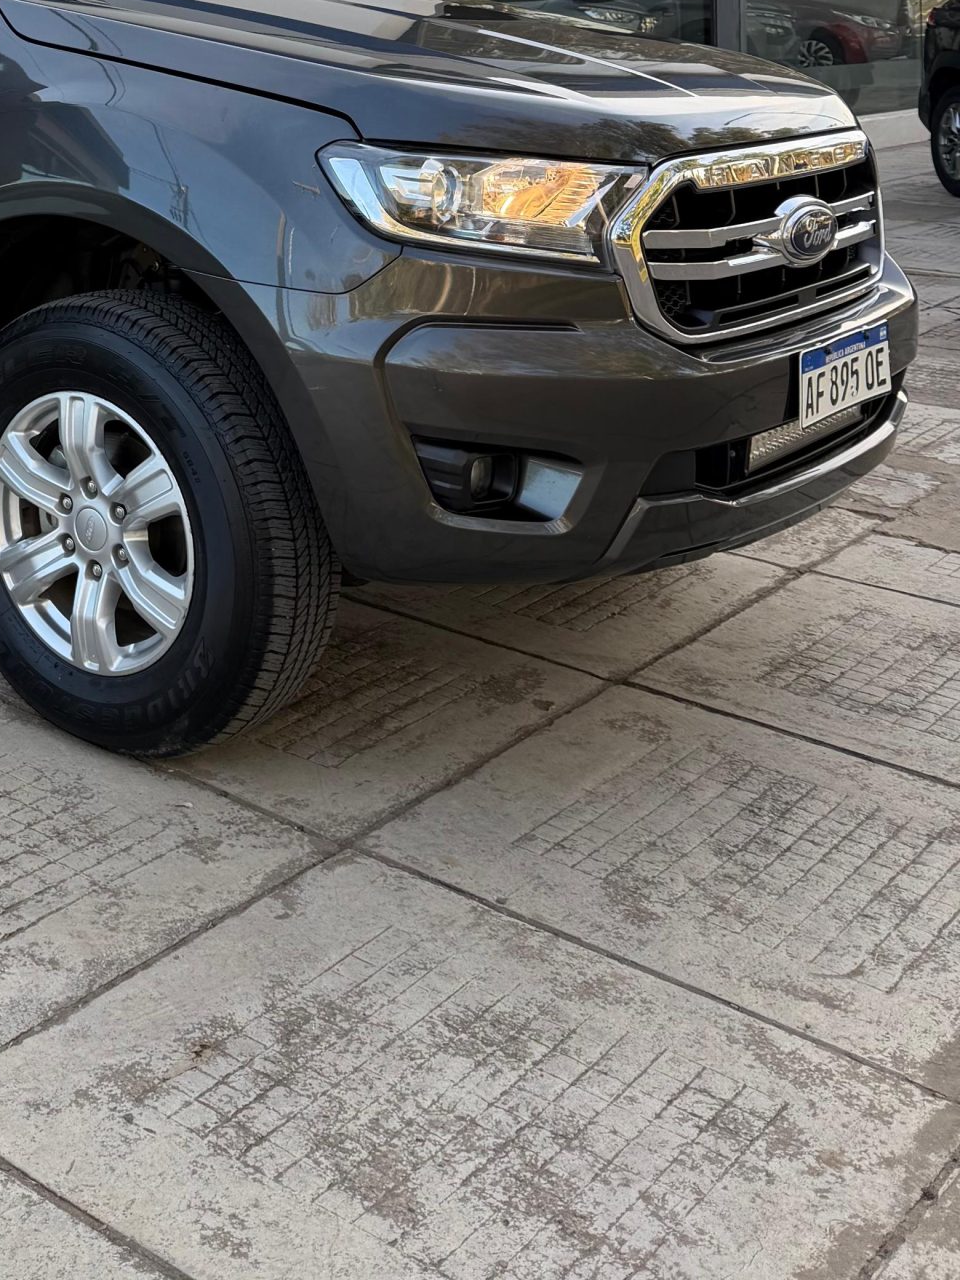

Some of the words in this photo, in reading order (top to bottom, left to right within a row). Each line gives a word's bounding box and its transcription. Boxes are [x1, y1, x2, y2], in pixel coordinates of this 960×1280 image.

[804, 217, 832, 248] Ford
[844, 341, 866, 355] ARGENTINA
[805, 371, 826, 420] AF
[830, 356, 859, 406] 895
[865, 347, 887, 391] OE
